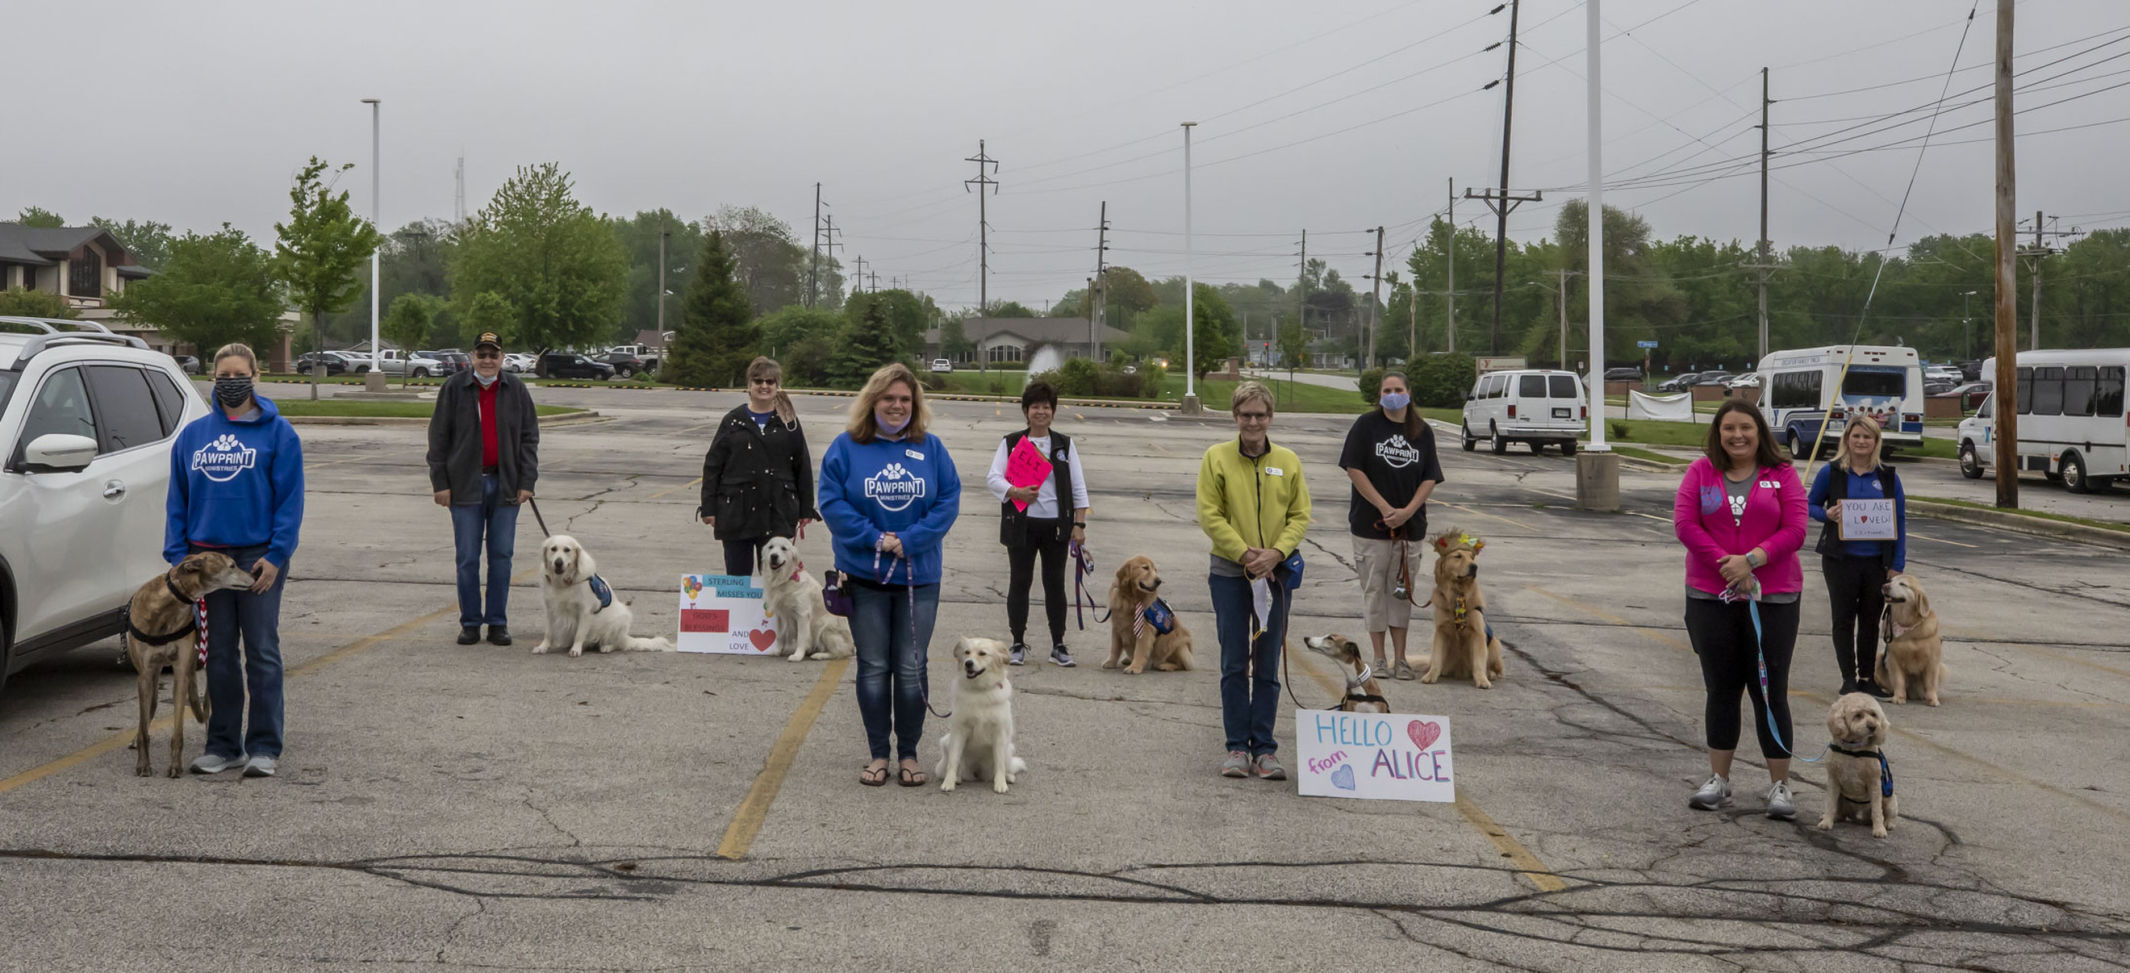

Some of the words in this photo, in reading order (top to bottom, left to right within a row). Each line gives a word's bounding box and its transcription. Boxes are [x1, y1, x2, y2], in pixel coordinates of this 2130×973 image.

[195, 451, 252, 467] PAWPRINT
[868, 480, 921, 494] PAWPRINT
[1846, 502, 1867, 511] YOU
[1872, 501, 1890, 511] ARE
[708, 577, 744, 586] STERLING
[717, 590, 745, 598] MISSES
[746, 591, 763, 599] YOU
[731, 630, 749, 638] AND
[1316, 714, 1392, 747] HELLO
[1308, 750, 1348, 775] from
[1371, 748, 1451, 782] ALICE
